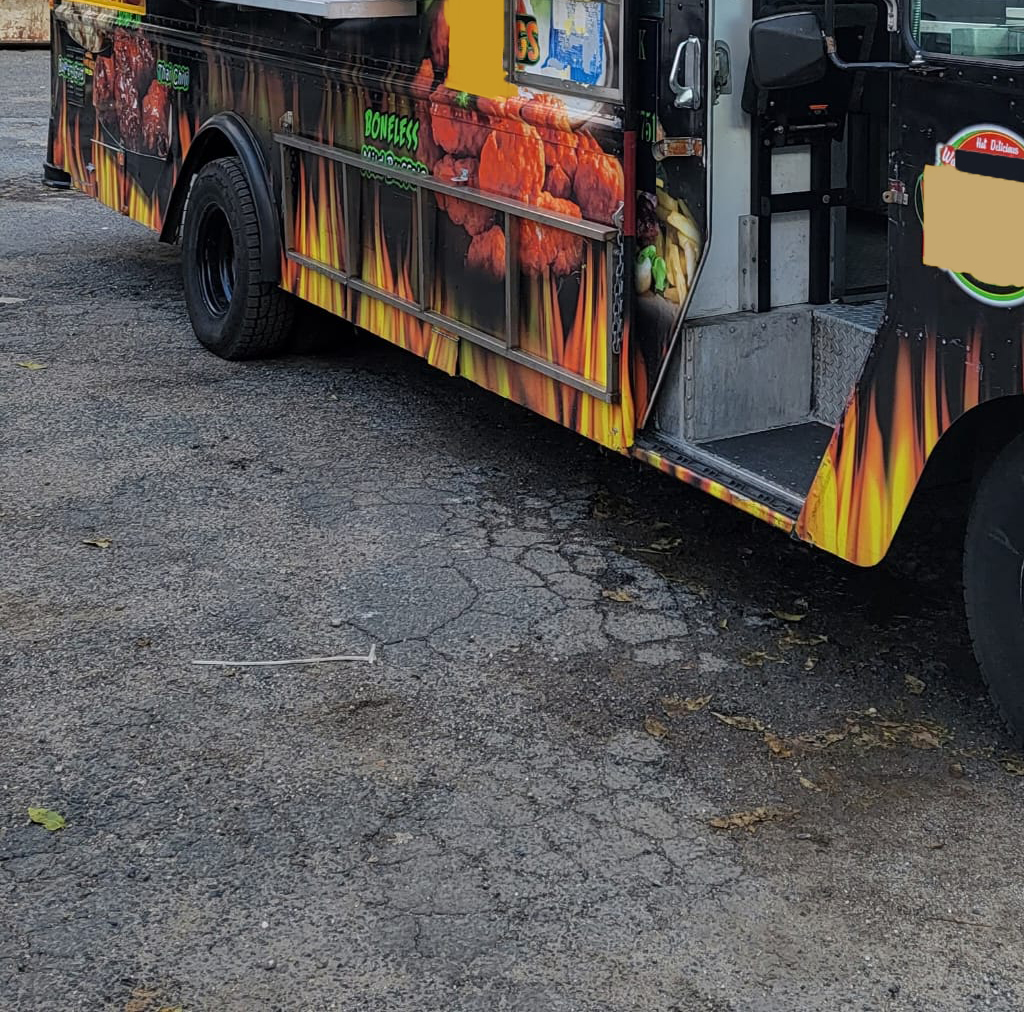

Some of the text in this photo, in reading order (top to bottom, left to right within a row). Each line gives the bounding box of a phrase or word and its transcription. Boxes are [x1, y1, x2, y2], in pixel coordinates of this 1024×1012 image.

[364, 108, 419, 152] BONELESS
[975, 136, 1020, 156] Hot Delicious
